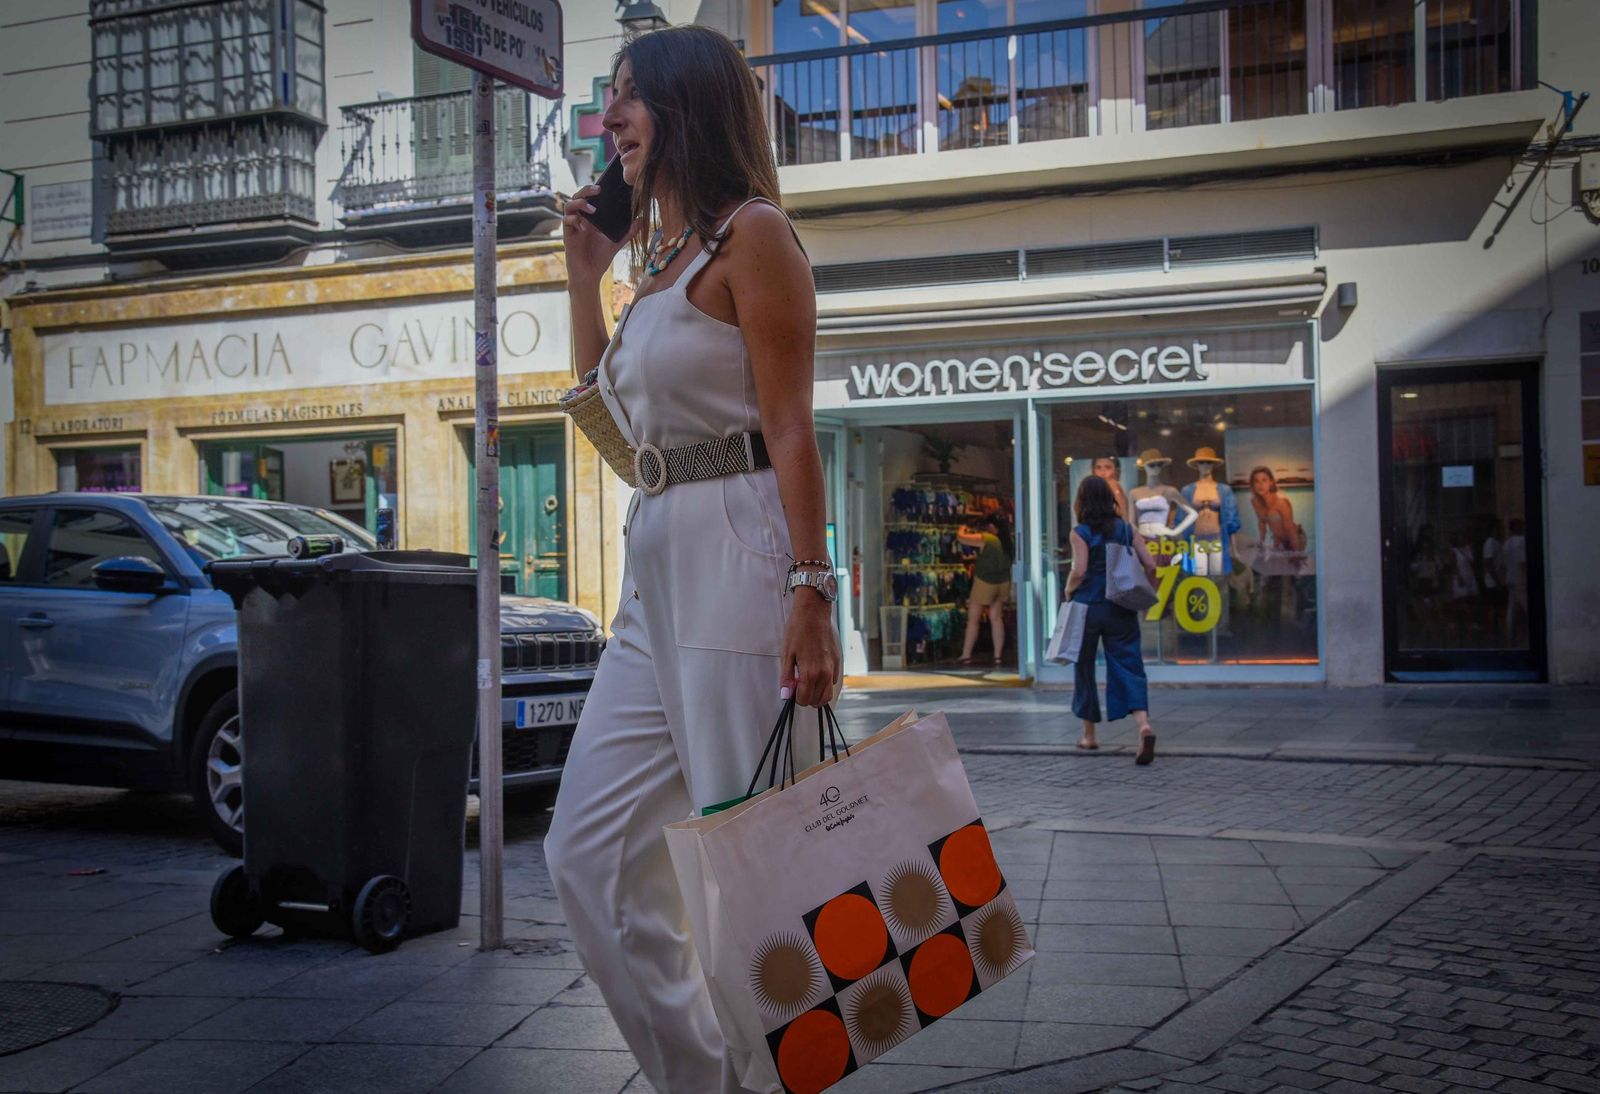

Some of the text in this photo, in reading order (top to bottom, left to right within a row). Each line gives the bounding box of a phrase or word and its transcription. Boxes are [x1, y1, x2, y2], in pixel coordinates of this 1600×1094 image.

[494, 27, 508, 53] DE
[850, 341, 1209, 396] women'secret
[281, 403, 363, 421] MAGISTRALES
[1145, 535, 1222, 559] ebajas
[530, 702, 564, 723] 1270
[805, 820, 822, 832] CLUB
[822, 813, 836, 823] DEL
[836, 795, 869, 815] GOURMET
